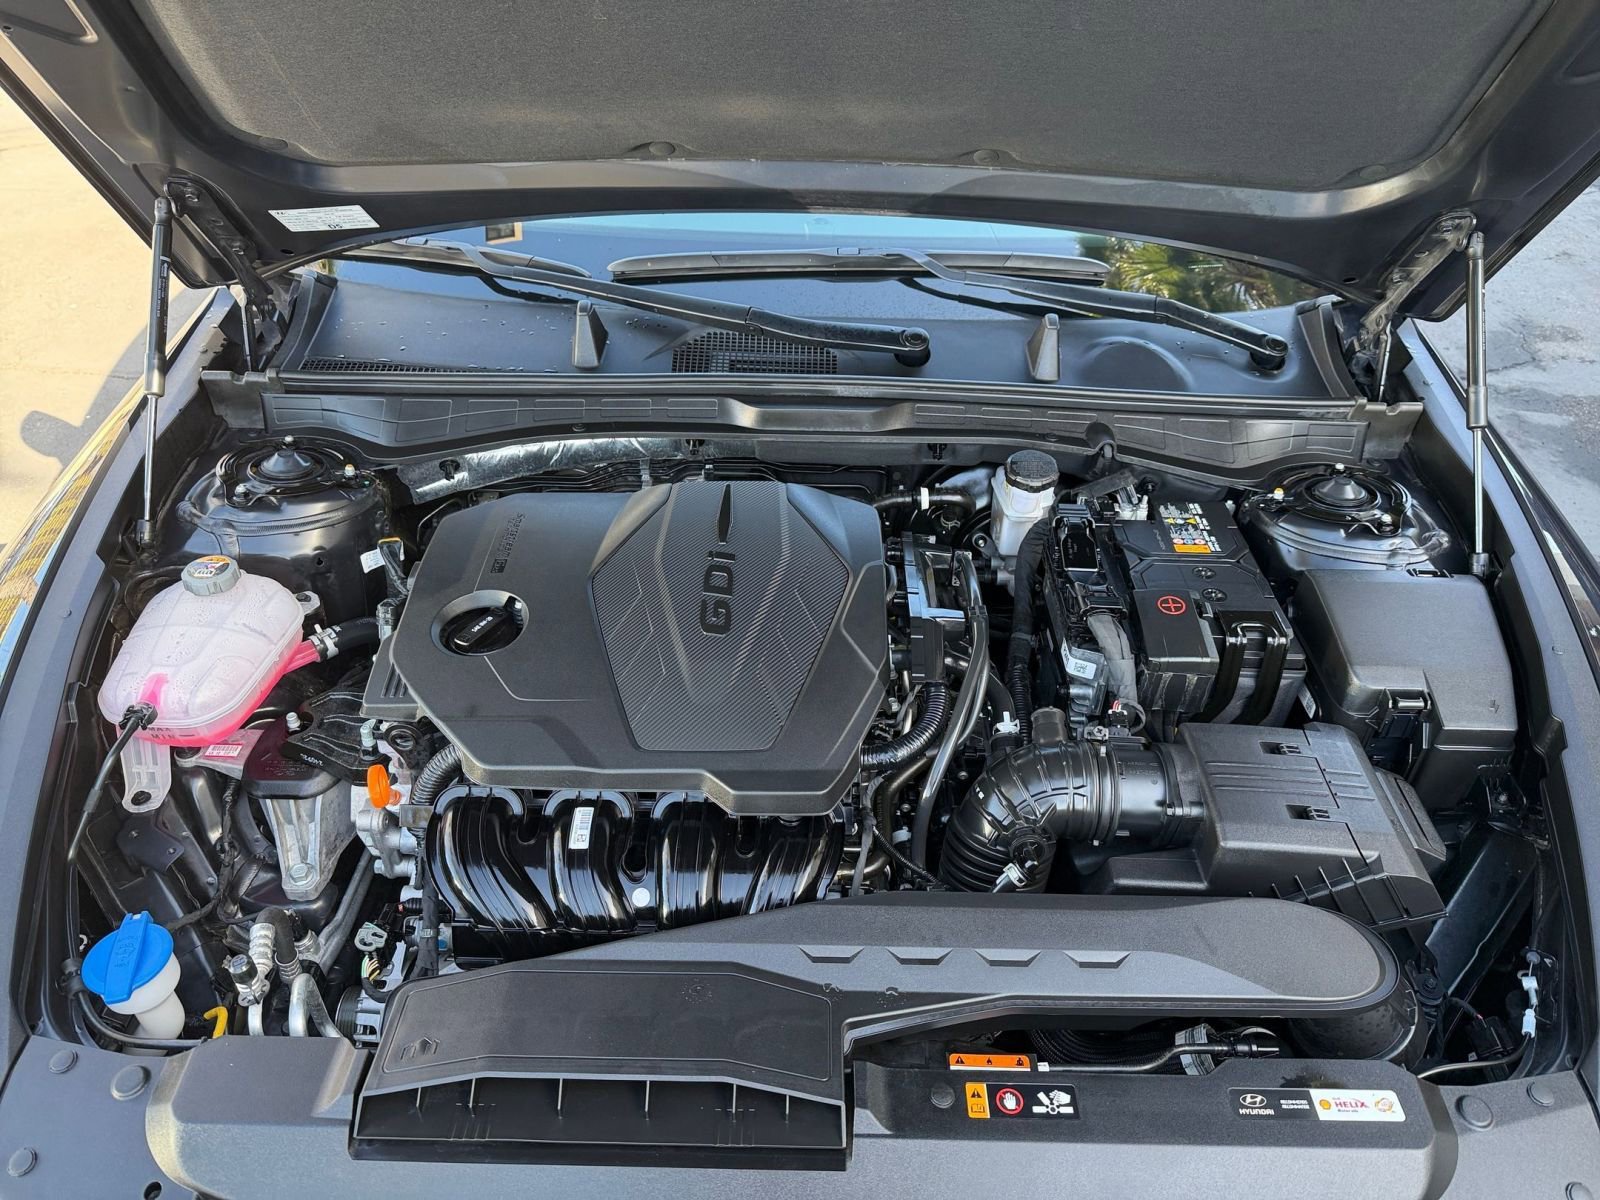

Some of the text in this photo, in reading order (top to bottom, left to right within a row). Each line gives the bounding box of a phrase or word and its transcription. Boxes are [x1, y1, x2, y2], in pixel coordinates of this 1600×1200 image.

[504, 511, 526, 558] Smartstream
[700, 550, 736, 636] GDi
[1334, 1100, 1369, 1109] HELIX
